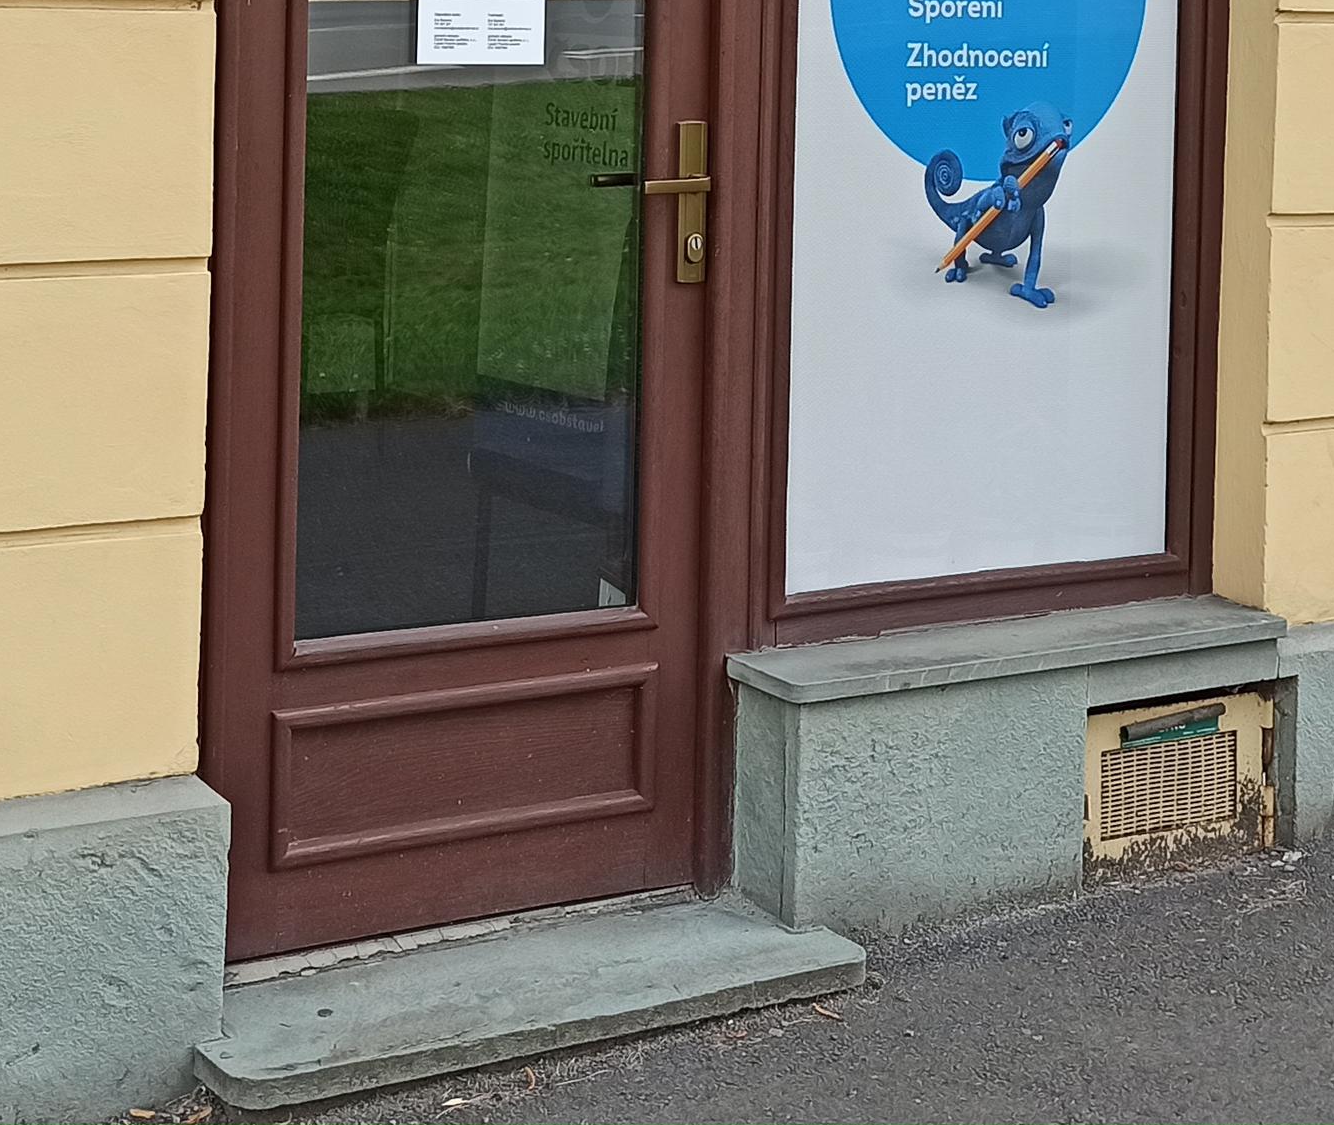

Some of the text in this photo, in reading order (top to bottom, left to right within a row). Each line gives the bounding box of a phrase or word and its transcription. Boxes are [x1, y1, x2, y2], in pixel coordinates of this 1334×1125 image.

[906, 42, 1049, 68] Zhodnocení
[905, 75, 978, 107] peněz
[545, 102, 619, 132] Stavební
[544, 137, 630, 168] spořitelna
